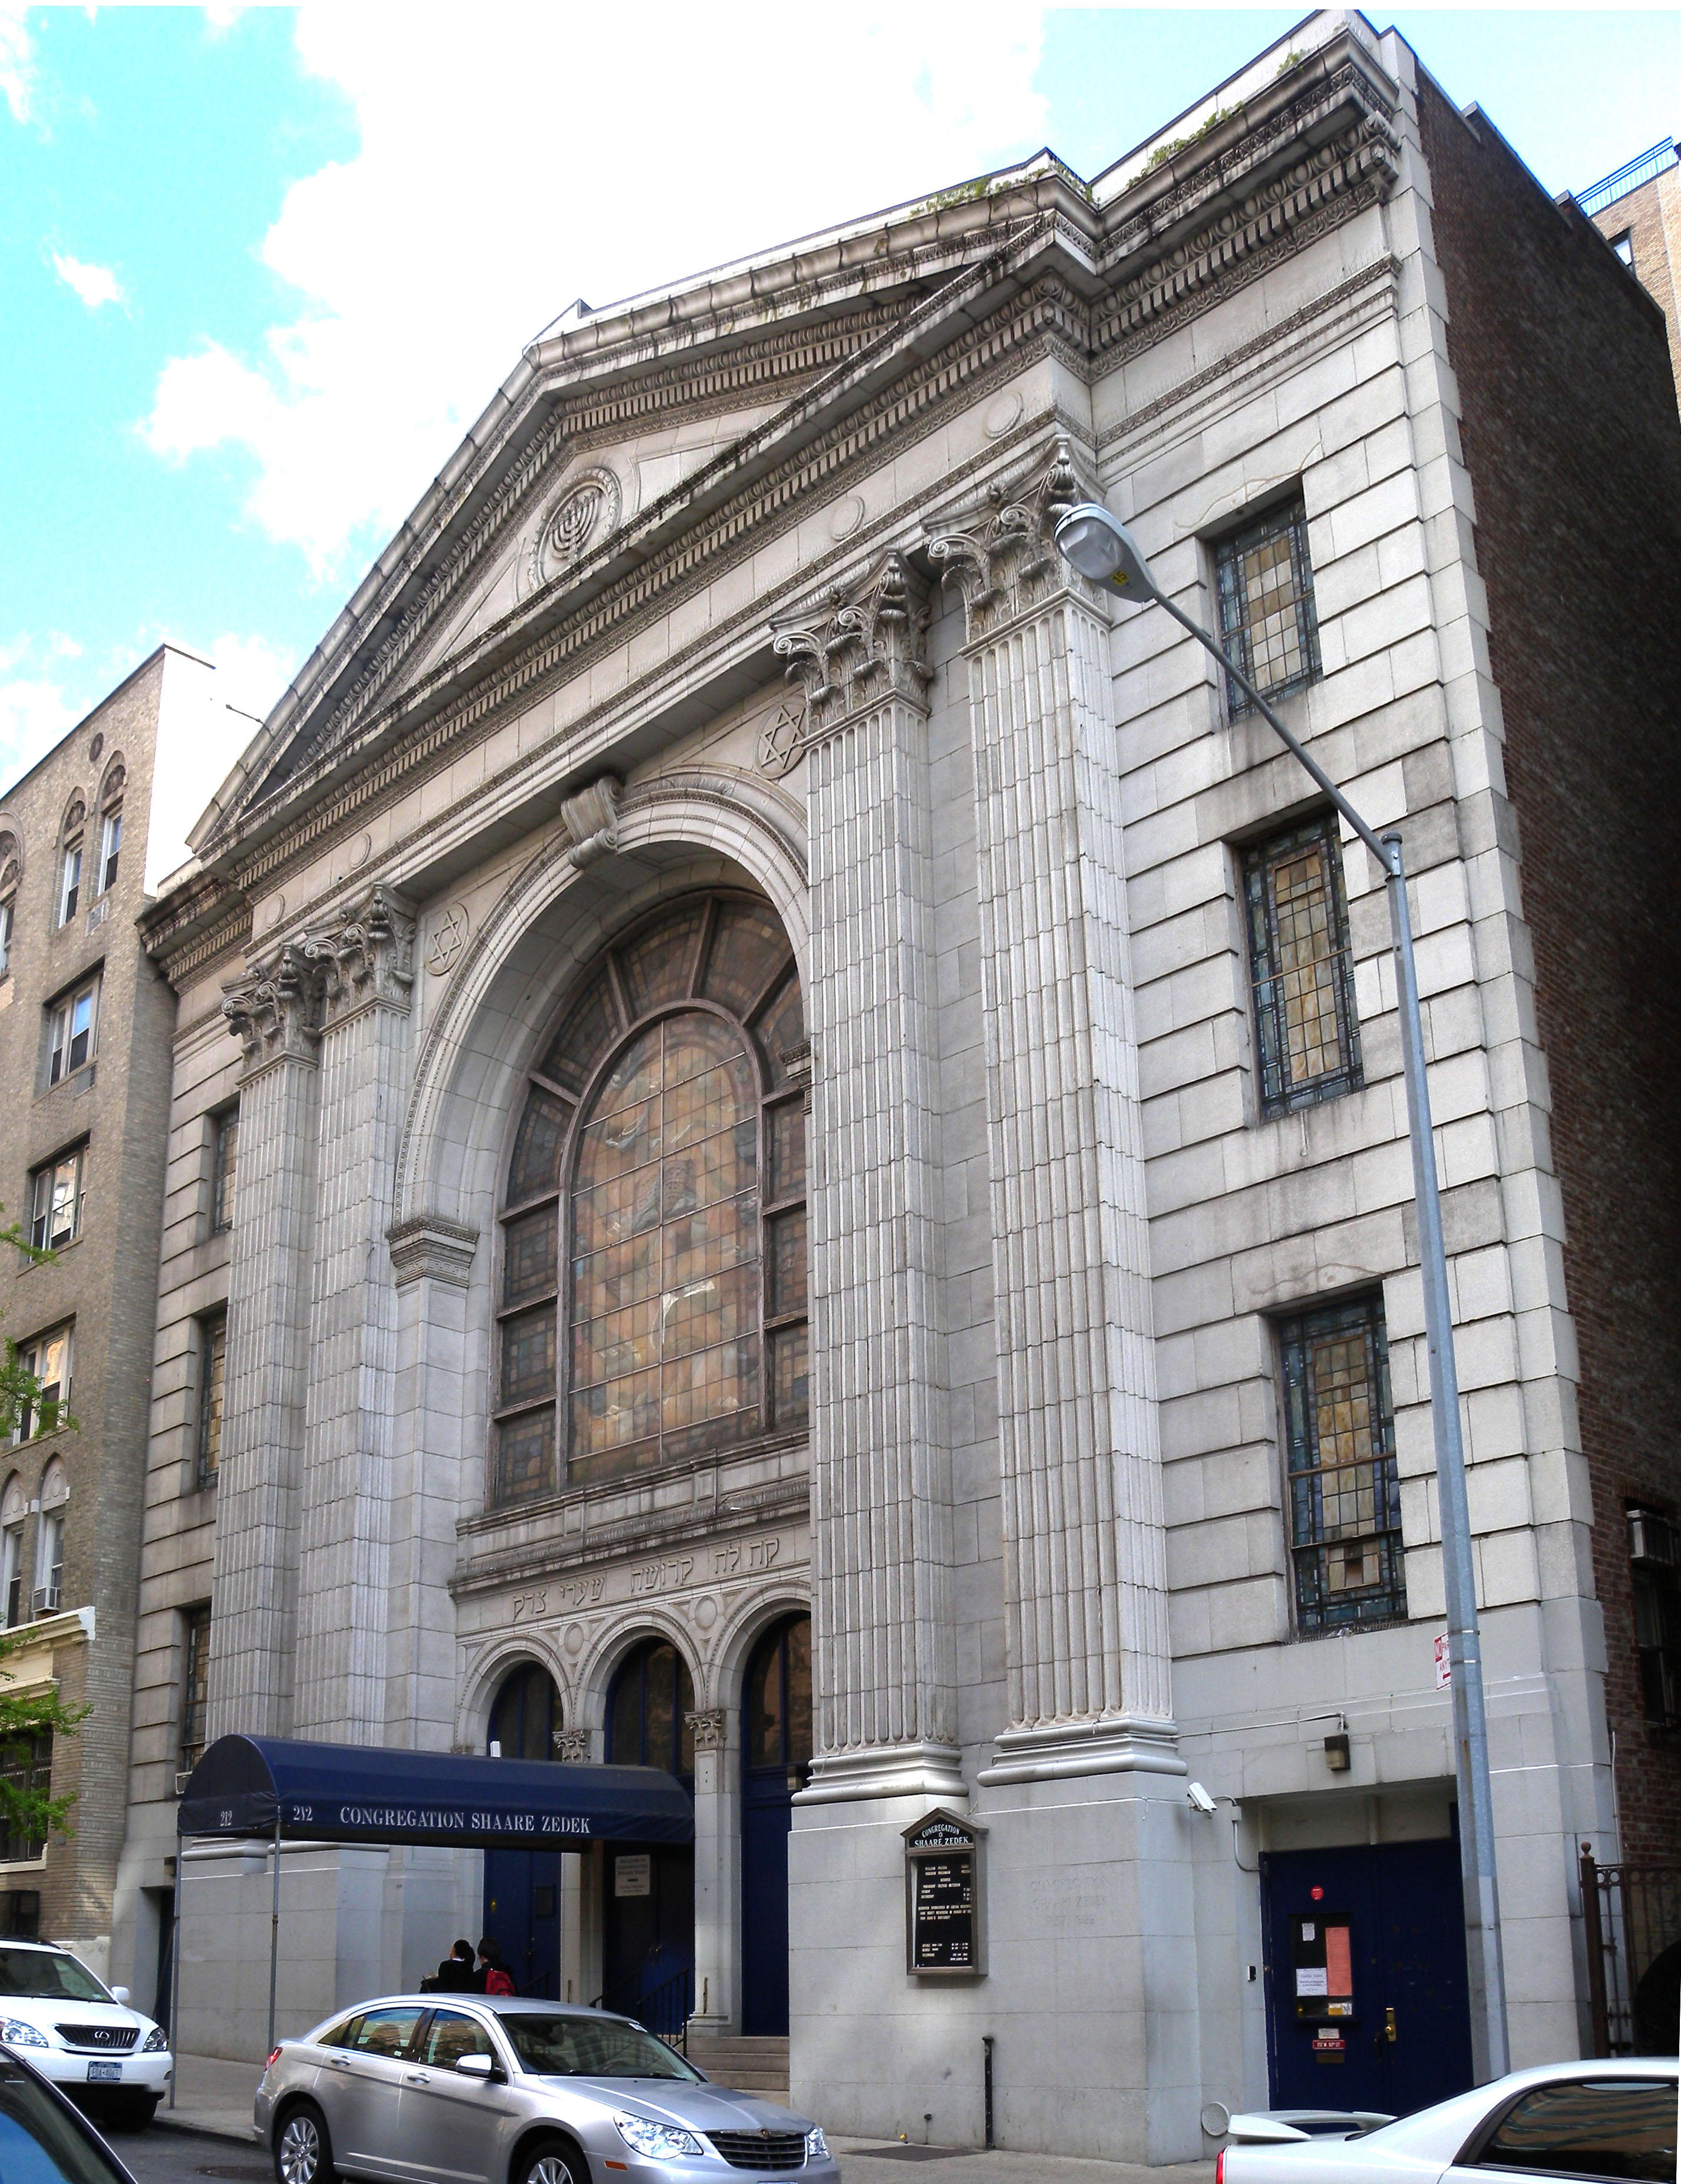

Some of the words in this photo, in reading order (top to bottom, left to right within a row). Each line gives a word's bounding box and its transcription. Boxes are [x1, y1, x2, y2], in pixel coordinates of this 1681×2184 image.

[1112, 571, 1127, 583] 15
[560, 1577, 606, 1606] שערי
[512, 1591, 547, 1623] צדק
[220, 1810, 233, 1826] 212
[293, 1805, 313, 1821] 212
[340, 1806, 465, 1828] CONGREGATION
[471, 1812, 534, 1831] SHAARE
[541, 1816, 591, 1834] ZEDEK
[922, 1824, 960, 1838] CONGREGATION
[914, 1838, 942, 1847] SHAARE
[944, 1836, 969, 1846] ZEDEK
